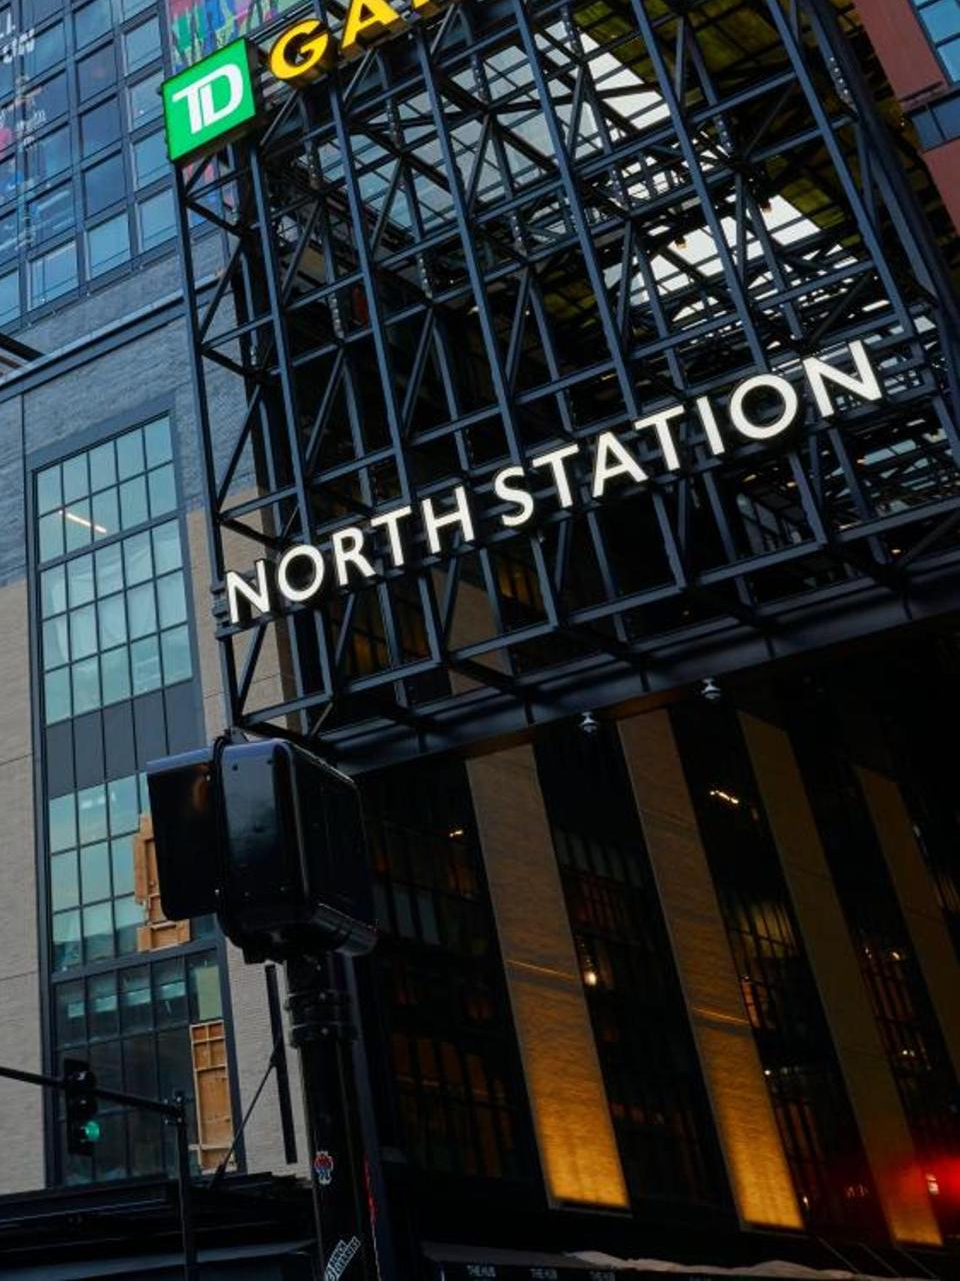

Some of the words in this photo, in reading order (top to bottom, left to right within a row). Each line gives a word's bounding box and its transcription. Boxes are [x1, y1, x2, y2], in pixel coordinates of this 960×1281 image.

[172, 63, 244, 135] TD
[225, 486, 477, 624] NORTH
[493, 339, 883, 528] STATION
